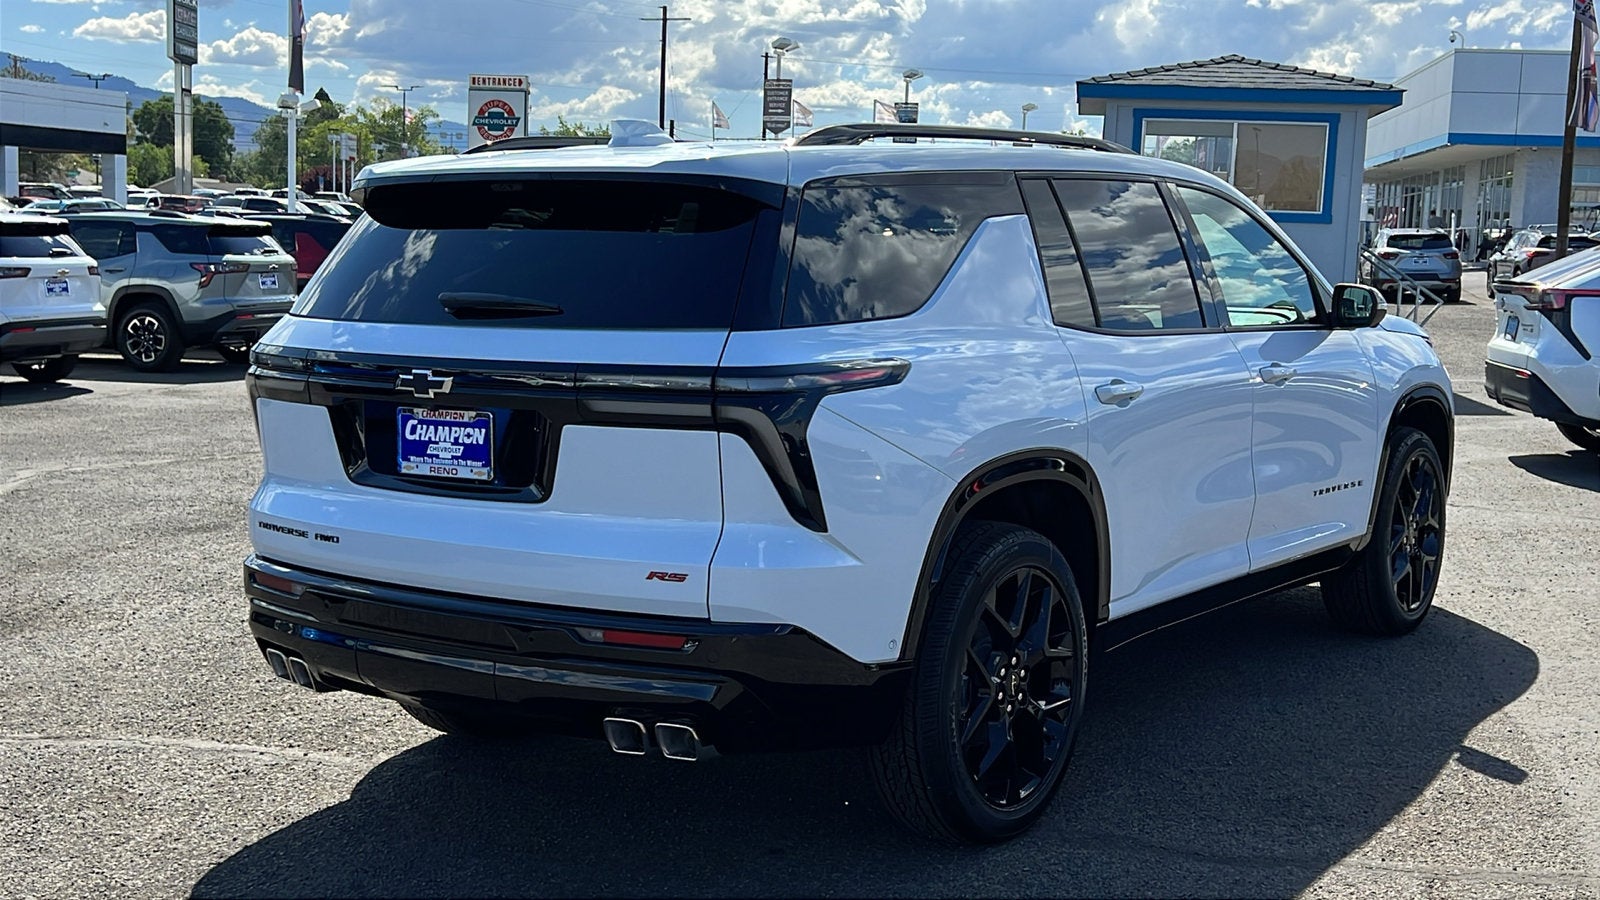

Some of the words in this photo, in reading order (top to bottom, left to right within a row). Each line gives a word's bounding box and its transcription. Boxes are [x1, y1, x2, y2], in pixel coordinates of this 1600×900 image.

[476, 77, 517, 87] ENTRANCE
[482, 100, 511, 112] SUPER
[421, 410, 465, 420] CHAMPION
[405, 419, 486, 445] CHAMPION
[429, 445, 461, 454] CHEVROLET
[429, 466, 459, 476] RENO
[1313, 479, 1364, 497] TRAVERSE
[258, 521, 309, 539] TRAVERSE
[314, 532, 340, 544] AWD
[645, 571, 689, 583] RS
